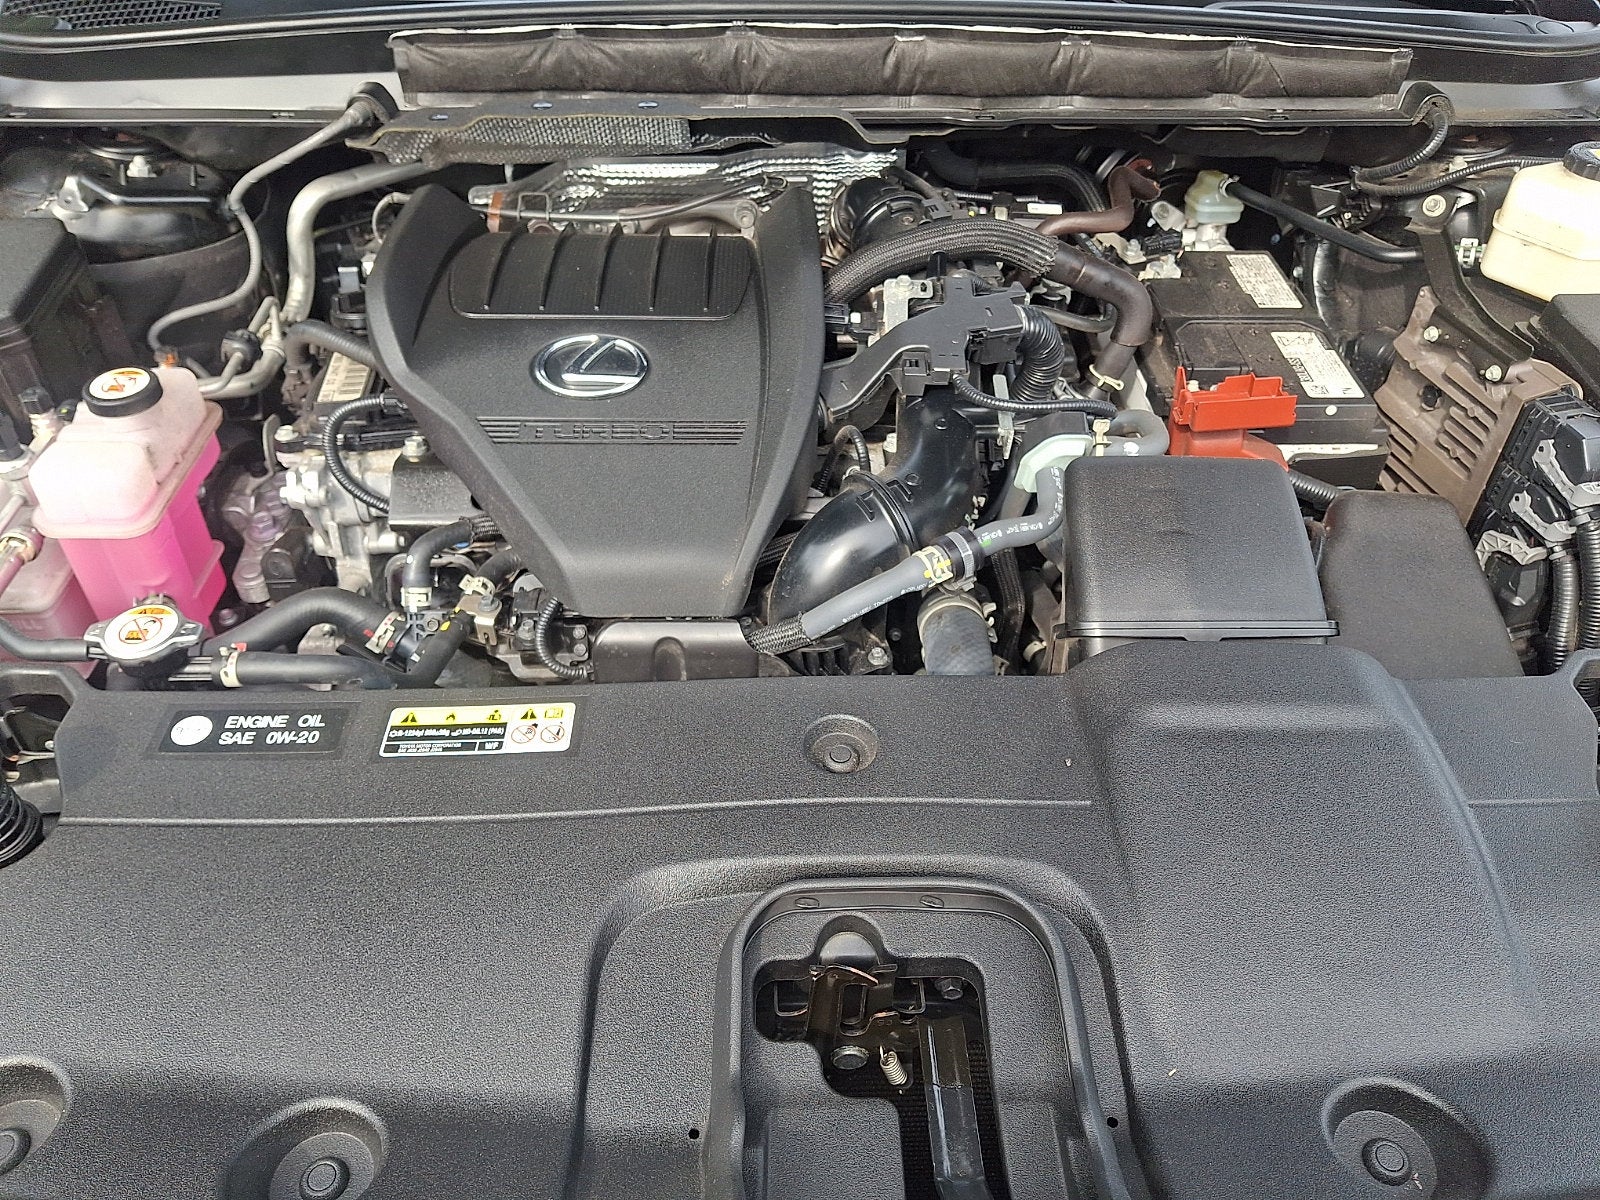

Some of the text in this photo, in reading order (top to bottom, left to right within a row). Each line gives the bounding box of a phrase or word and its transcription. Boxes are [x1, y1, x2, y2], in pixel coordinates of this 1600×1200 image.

[524, 423, 669, 440] TURBO
[225, 714, 325, 728] ENGINE OIL
[218, 731, 320, 745] SAE 0W-20
